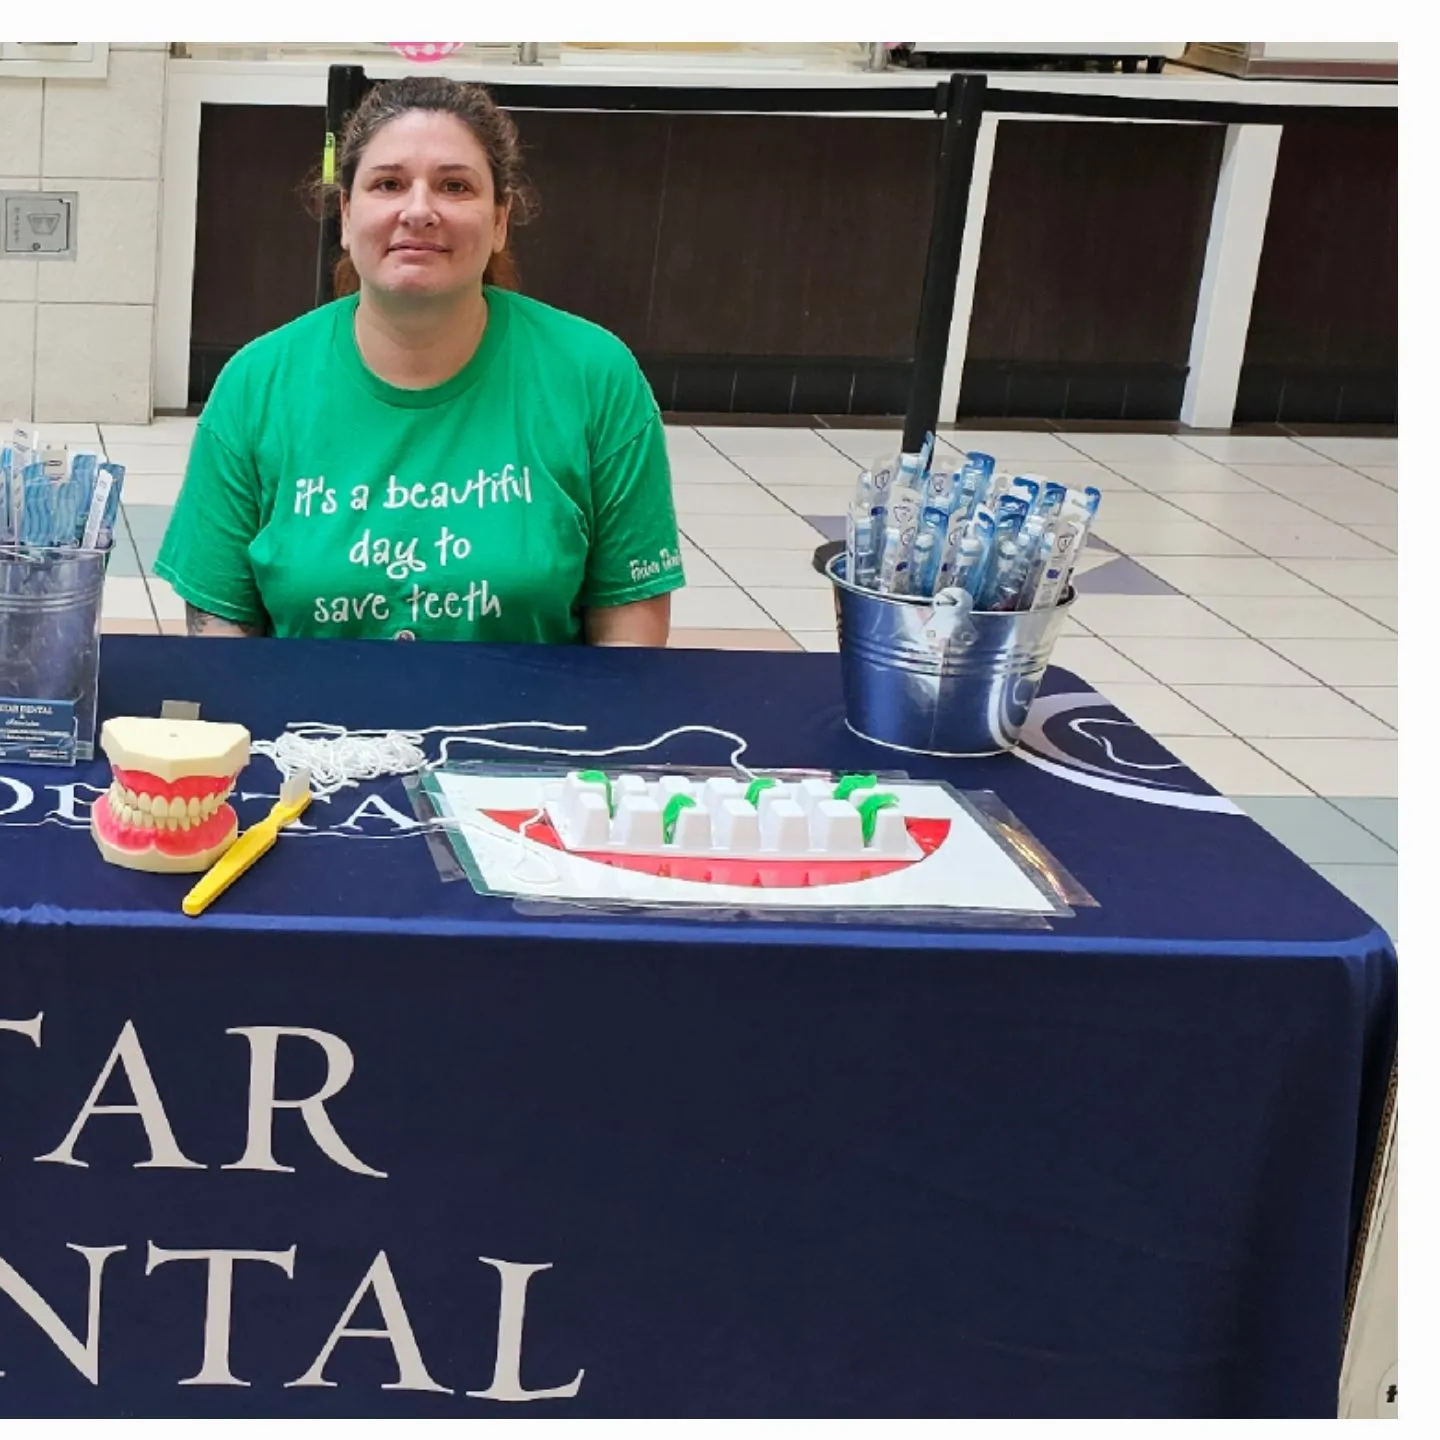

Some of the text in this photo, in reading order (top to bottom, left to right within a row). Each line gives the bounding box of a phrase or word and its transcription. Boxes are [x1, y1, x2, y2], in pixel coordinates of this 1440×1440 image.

[294, 464, 532, 517] it's a beautiful
[349, 526, 472, 579] day to
[314, 580, 502, 623] save teeth
